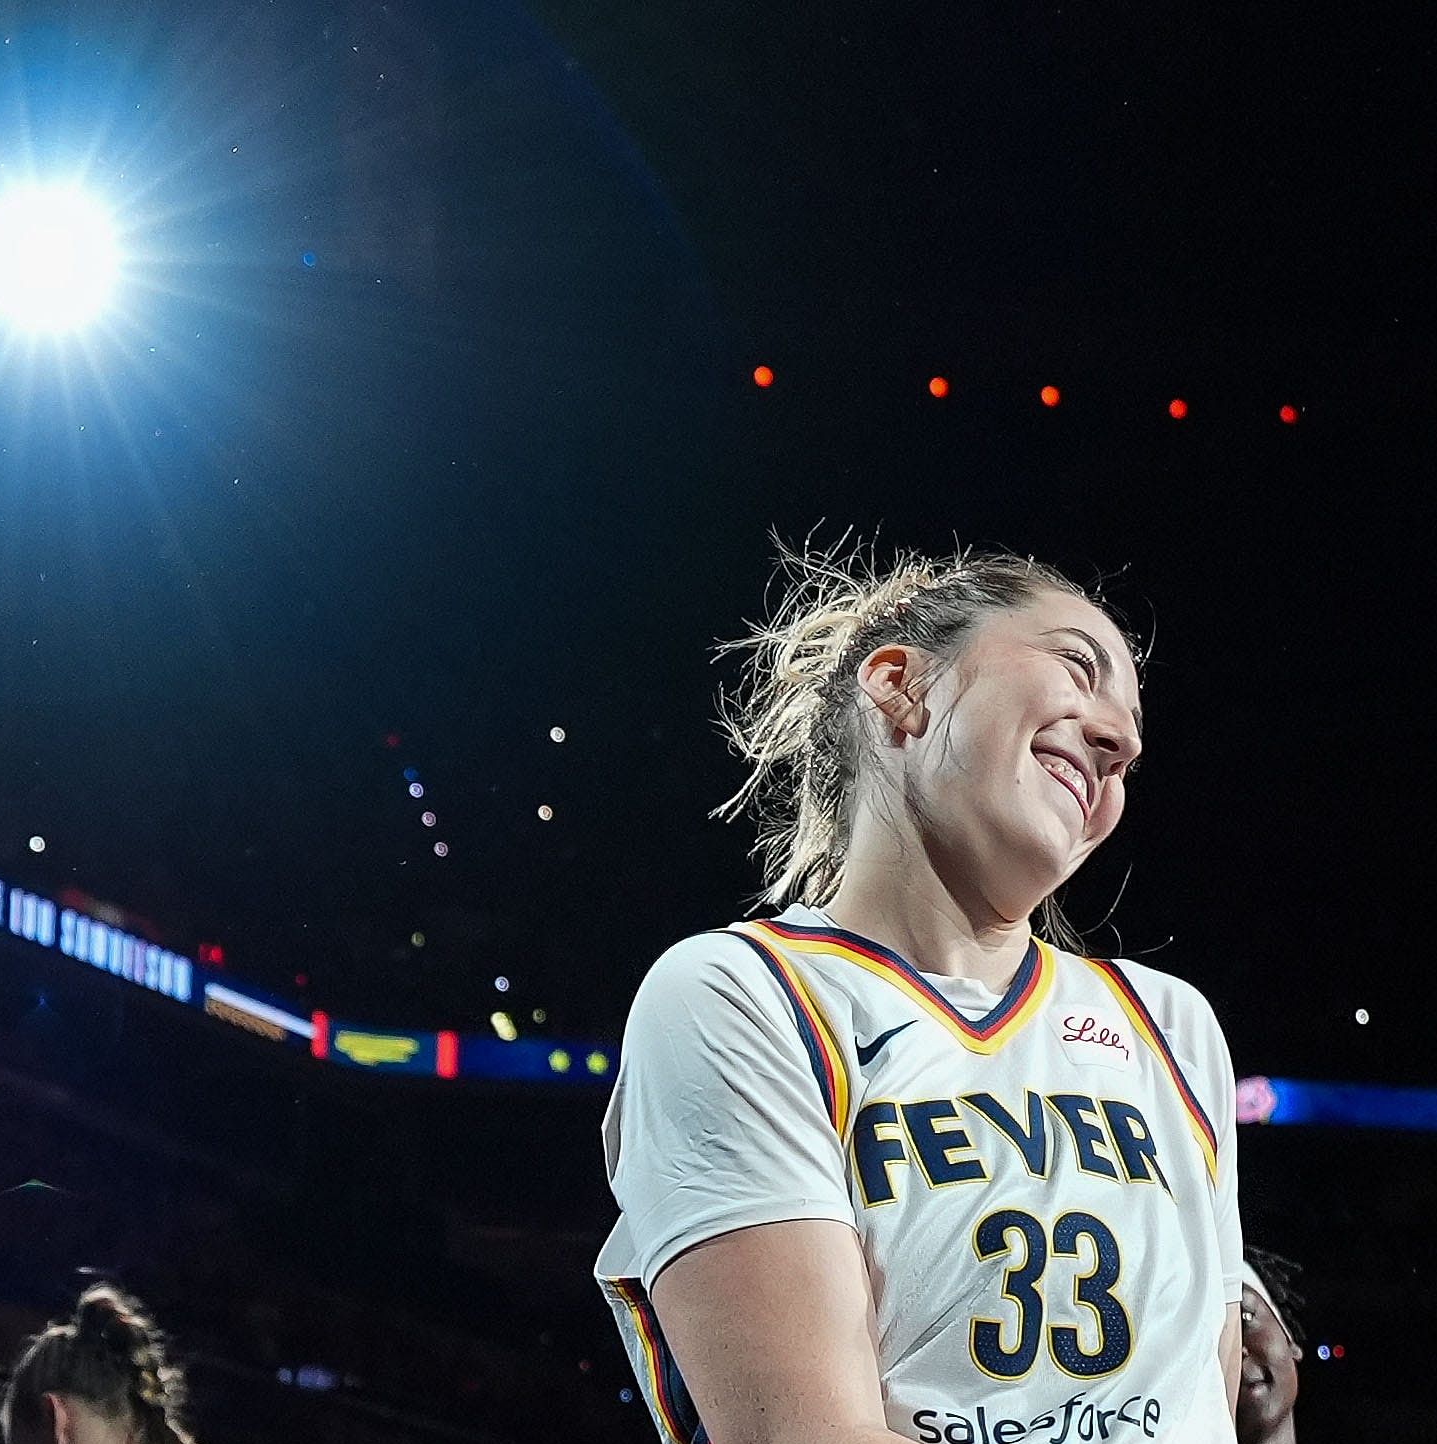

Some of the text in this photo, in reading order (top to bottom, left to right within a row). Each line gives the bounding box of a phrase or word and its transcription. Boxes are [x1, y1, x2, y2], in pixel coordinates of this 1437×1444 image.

[1061, 1016, 1130, 1061] Lilly
[850, 1088, 1177, 1208] FEVER
[968, 1209, 1134, 1382] 33
